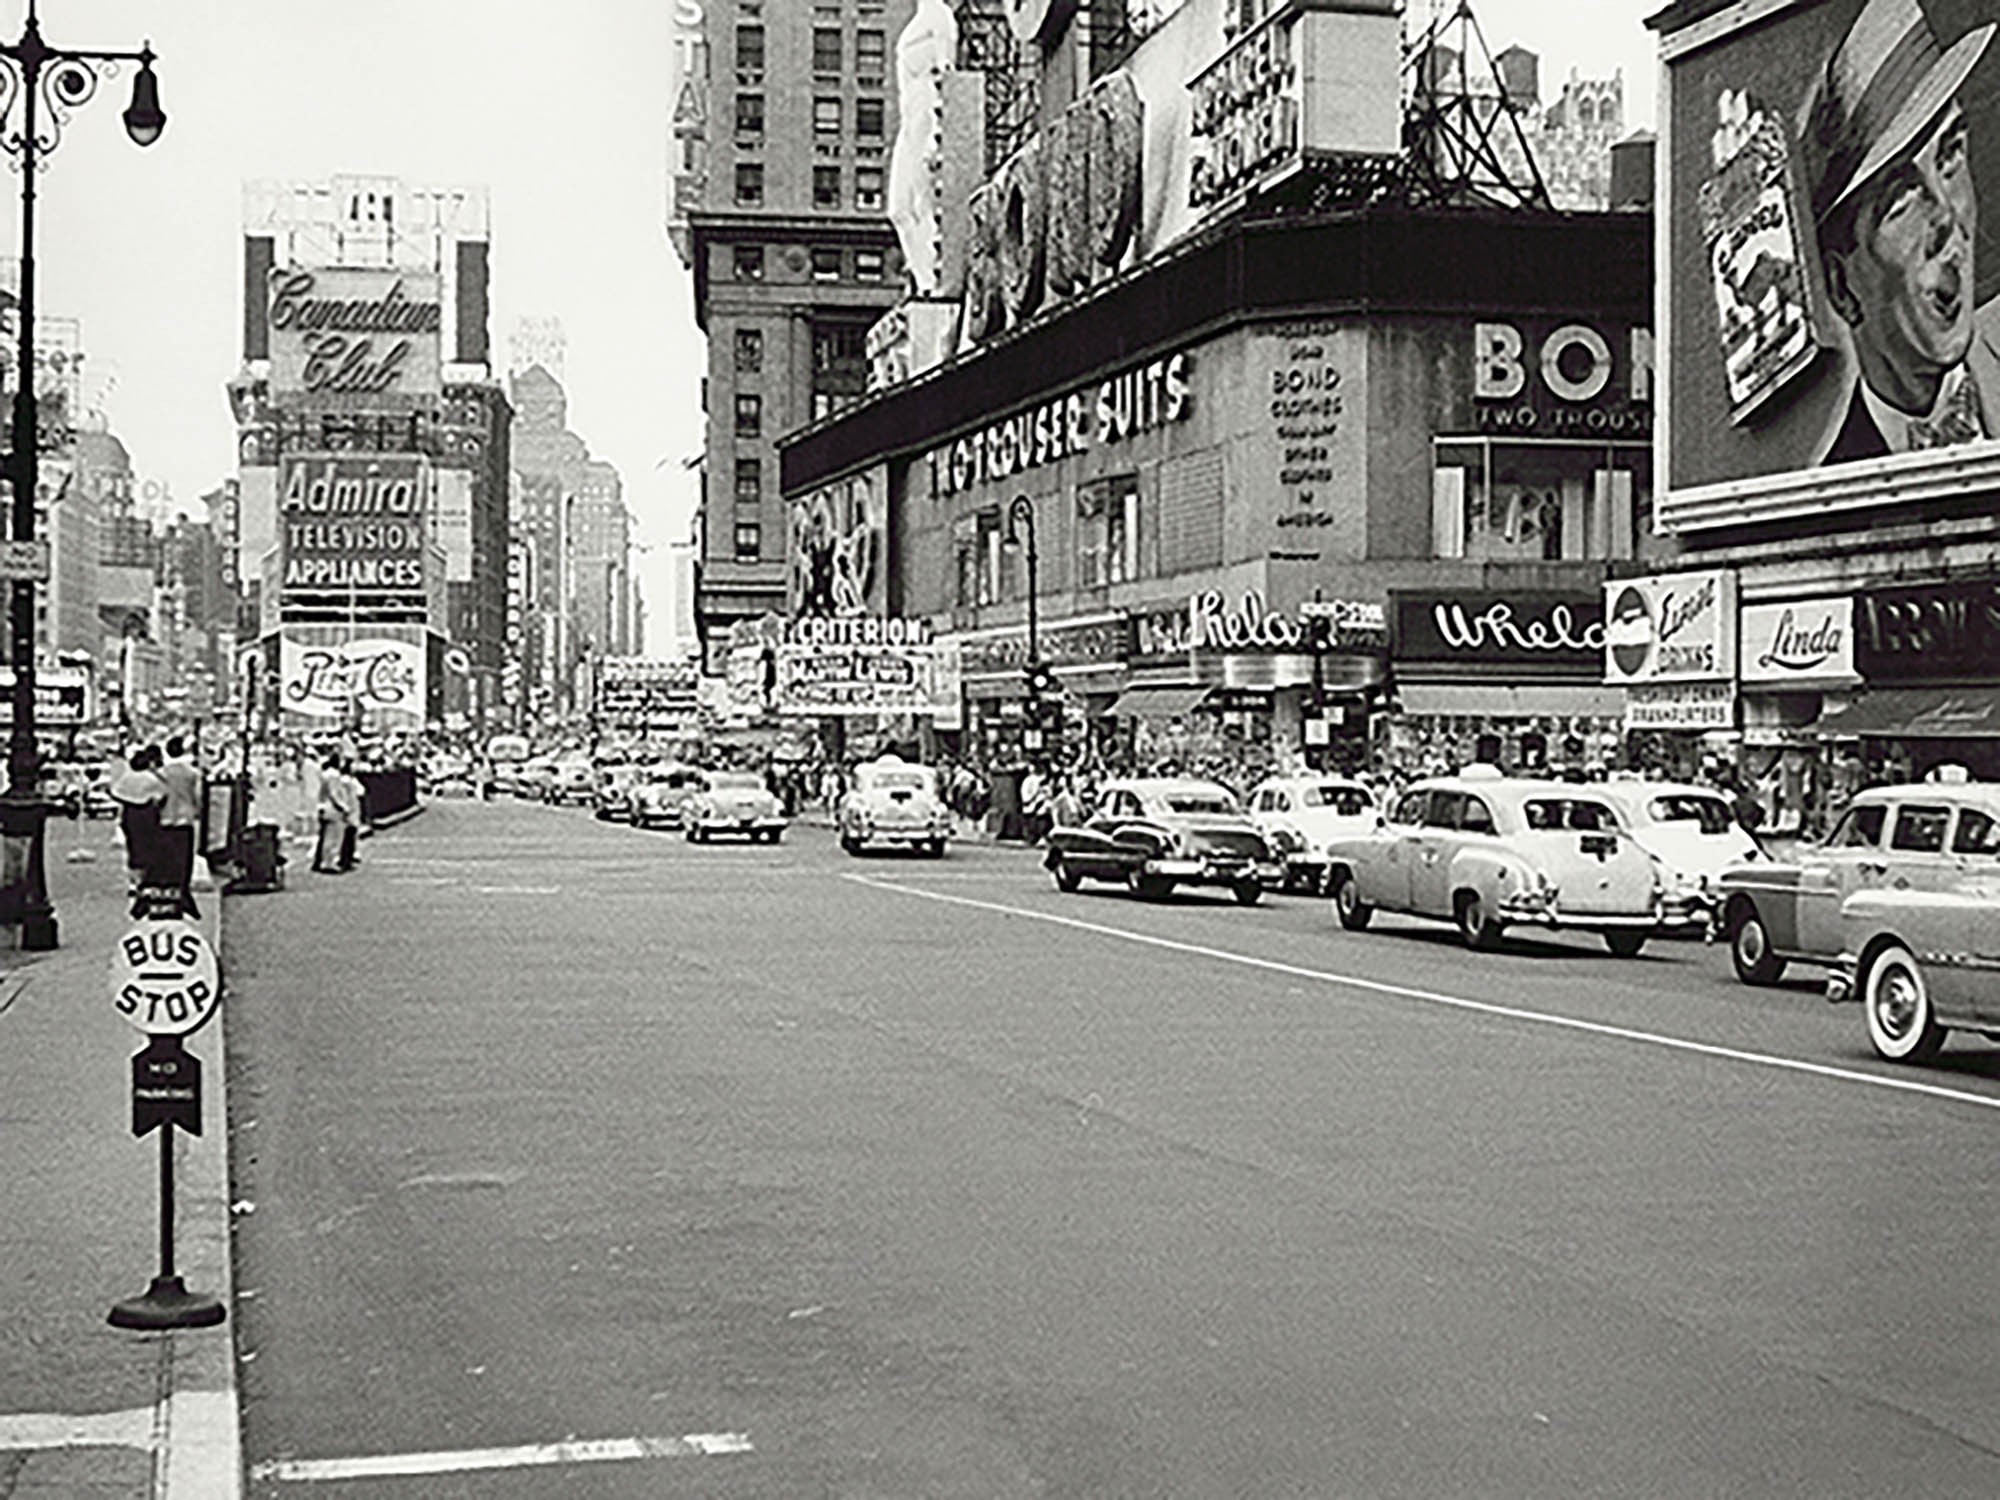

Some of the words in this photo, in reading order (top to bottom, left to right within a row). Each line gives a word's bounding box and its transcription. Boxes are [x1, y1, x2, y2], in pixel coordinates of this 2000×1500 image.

[270, 267, 441, 333] Canadian
[302, 332, 411, 393] Club
[1273, 367, 1341, 394] BOND
[973, 393, 1088, 483] TROUSER
[1096, 353, 1191, 443] SUITS
[1477, 405, 1537, 428] TWO
[282, 461, 429, 513] Admiral
[288, 523, 421, 549] TELEVISION
[285, 558, 422, 585] APPLIANCES
[798, 616, 921, 645] CRITERION
[1757, 608, 1844, 670] Linda
[122, 934, 201, 967] BUS
[115, 980, 210, 1022] STOP
